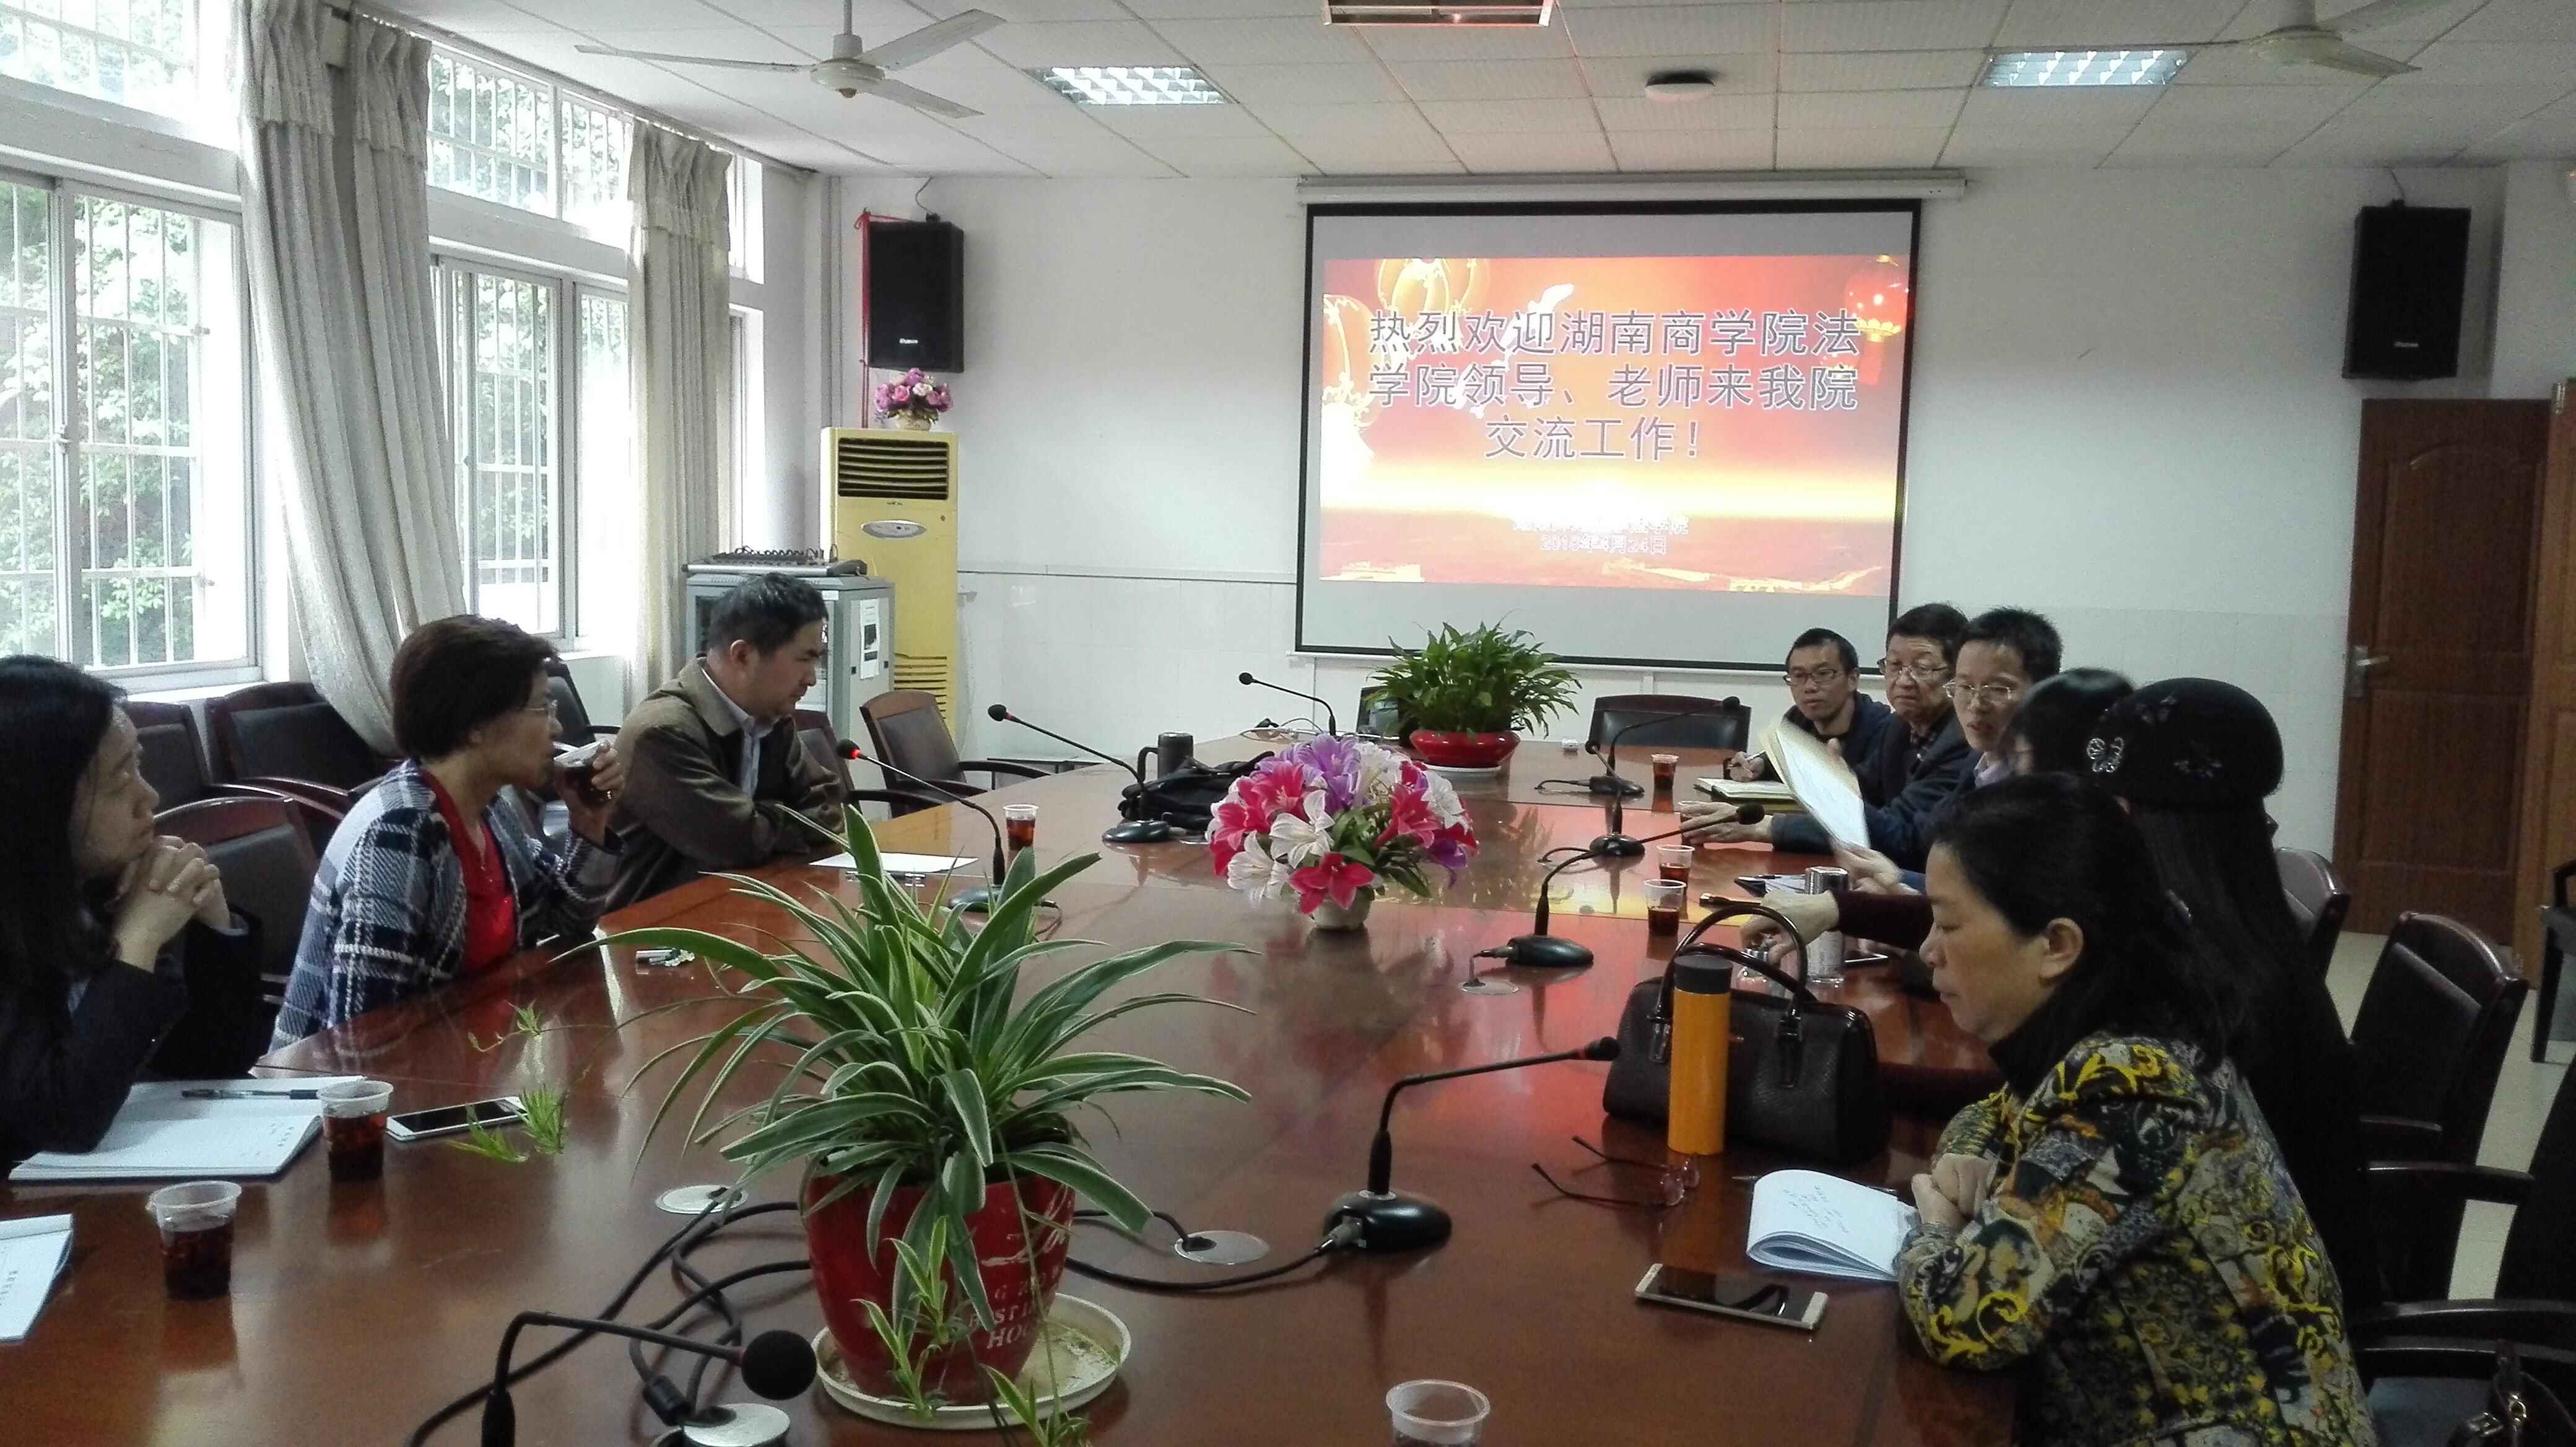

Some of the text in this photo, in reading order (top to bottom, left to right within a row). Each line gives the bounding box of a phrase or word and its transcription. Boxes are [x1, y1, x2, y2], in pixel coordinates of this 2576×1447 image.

[1369, 308, 1860, 356] 热烈欢迎湖南商学院法
[1368, 362, 1858, 411] 学院领导、老师来我院
